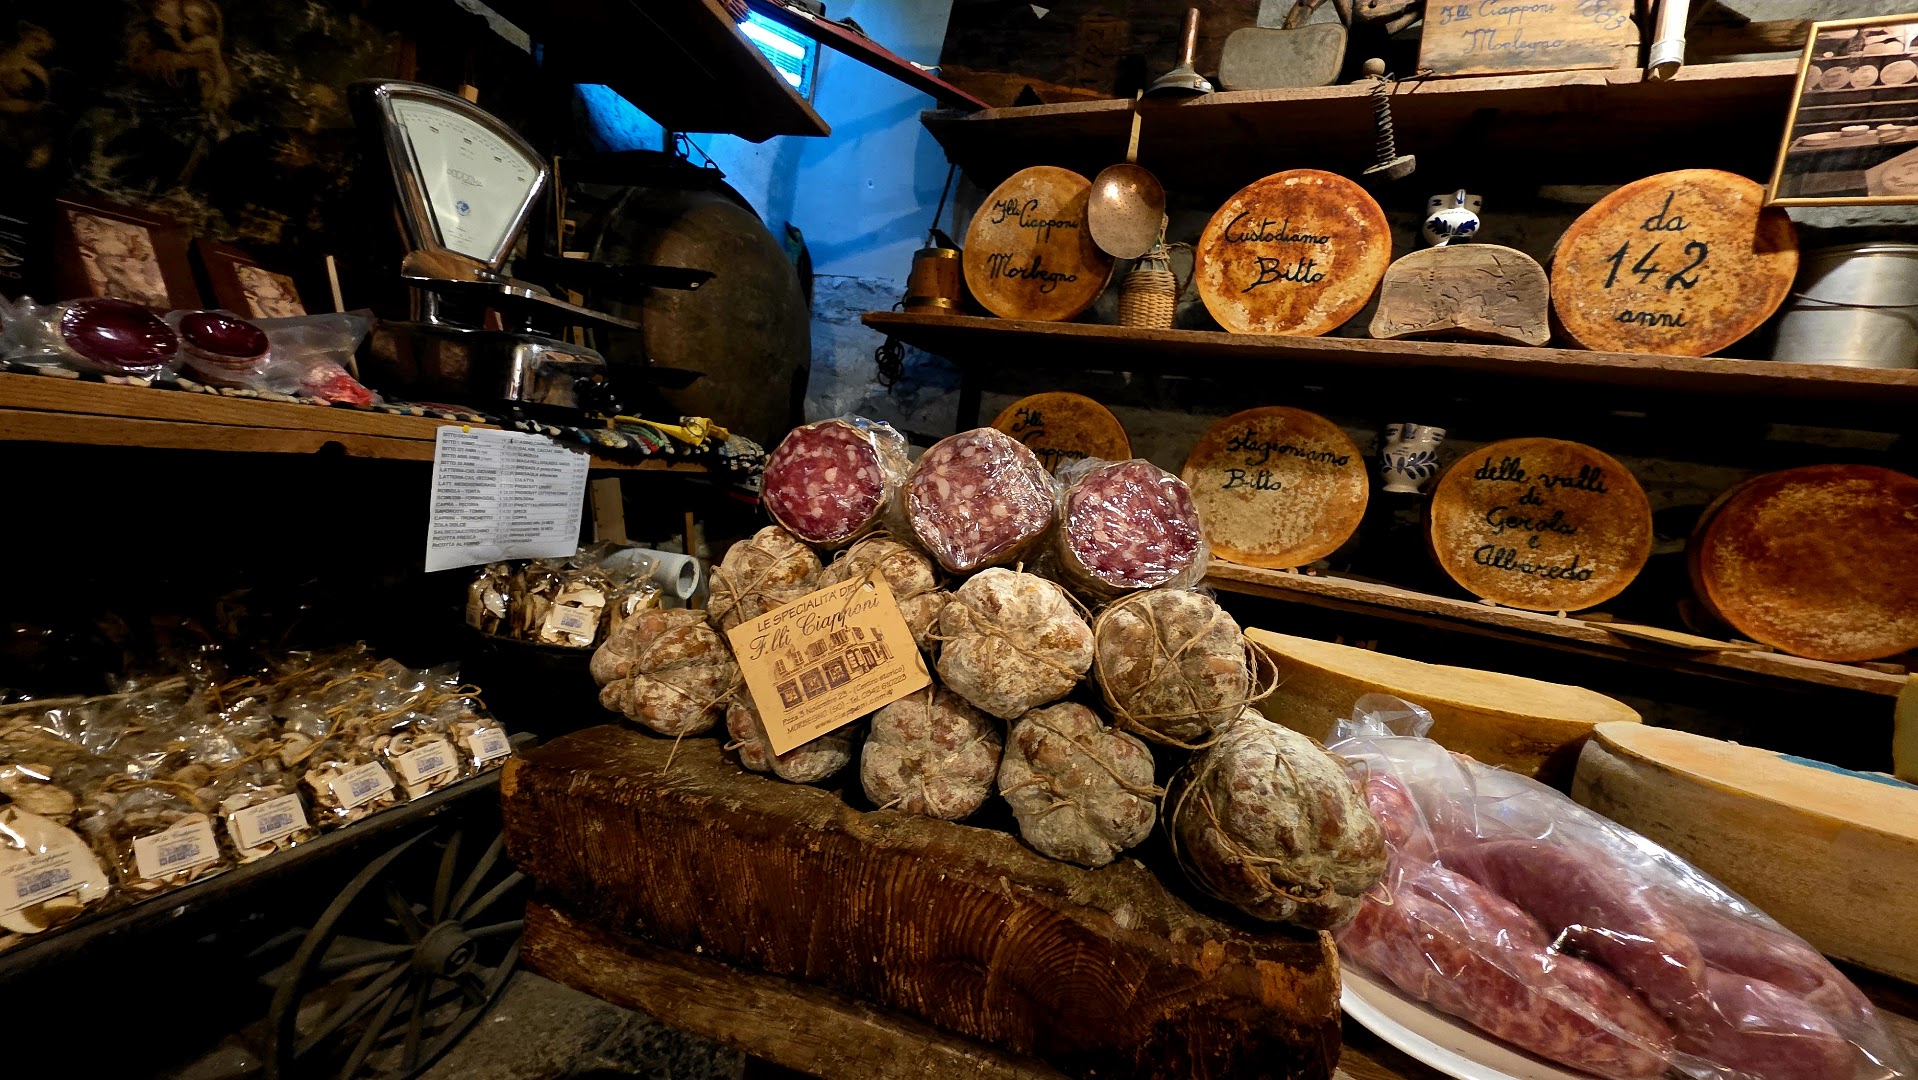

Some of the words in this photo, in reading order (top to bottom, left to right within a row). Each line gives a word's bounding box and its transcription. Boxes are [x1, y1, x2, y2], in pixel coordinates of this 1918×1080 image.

[1019, 199, 1078, 244] Ciapponi
[1224, 211, 1330, 245] Custodiamo
[1639, 190, 1692, 232] da
[987, 252, 1078, 294] Morbegno
[1241, 256, 1327, 294] Bitto
[1604, 239, 1709, 290] 142
[1615, 307, 1689, 328] anni
[1222, 468, 1282, 491] Bitto
[1474, 456, 1529, 483] delle
[1538, 464, 1609, 494] valli
[1519, 486, 1544, 506] di
[1485, 506, 1578, 535] Gerola
[1526, 534, 1543, 550] e
[1473, 544, 1595, 582] Albaredo
[748, 625, 792, 661] F.lli
[795, 592, 880, 637] Ciapponi
[757, 618, 772, 633] LE
